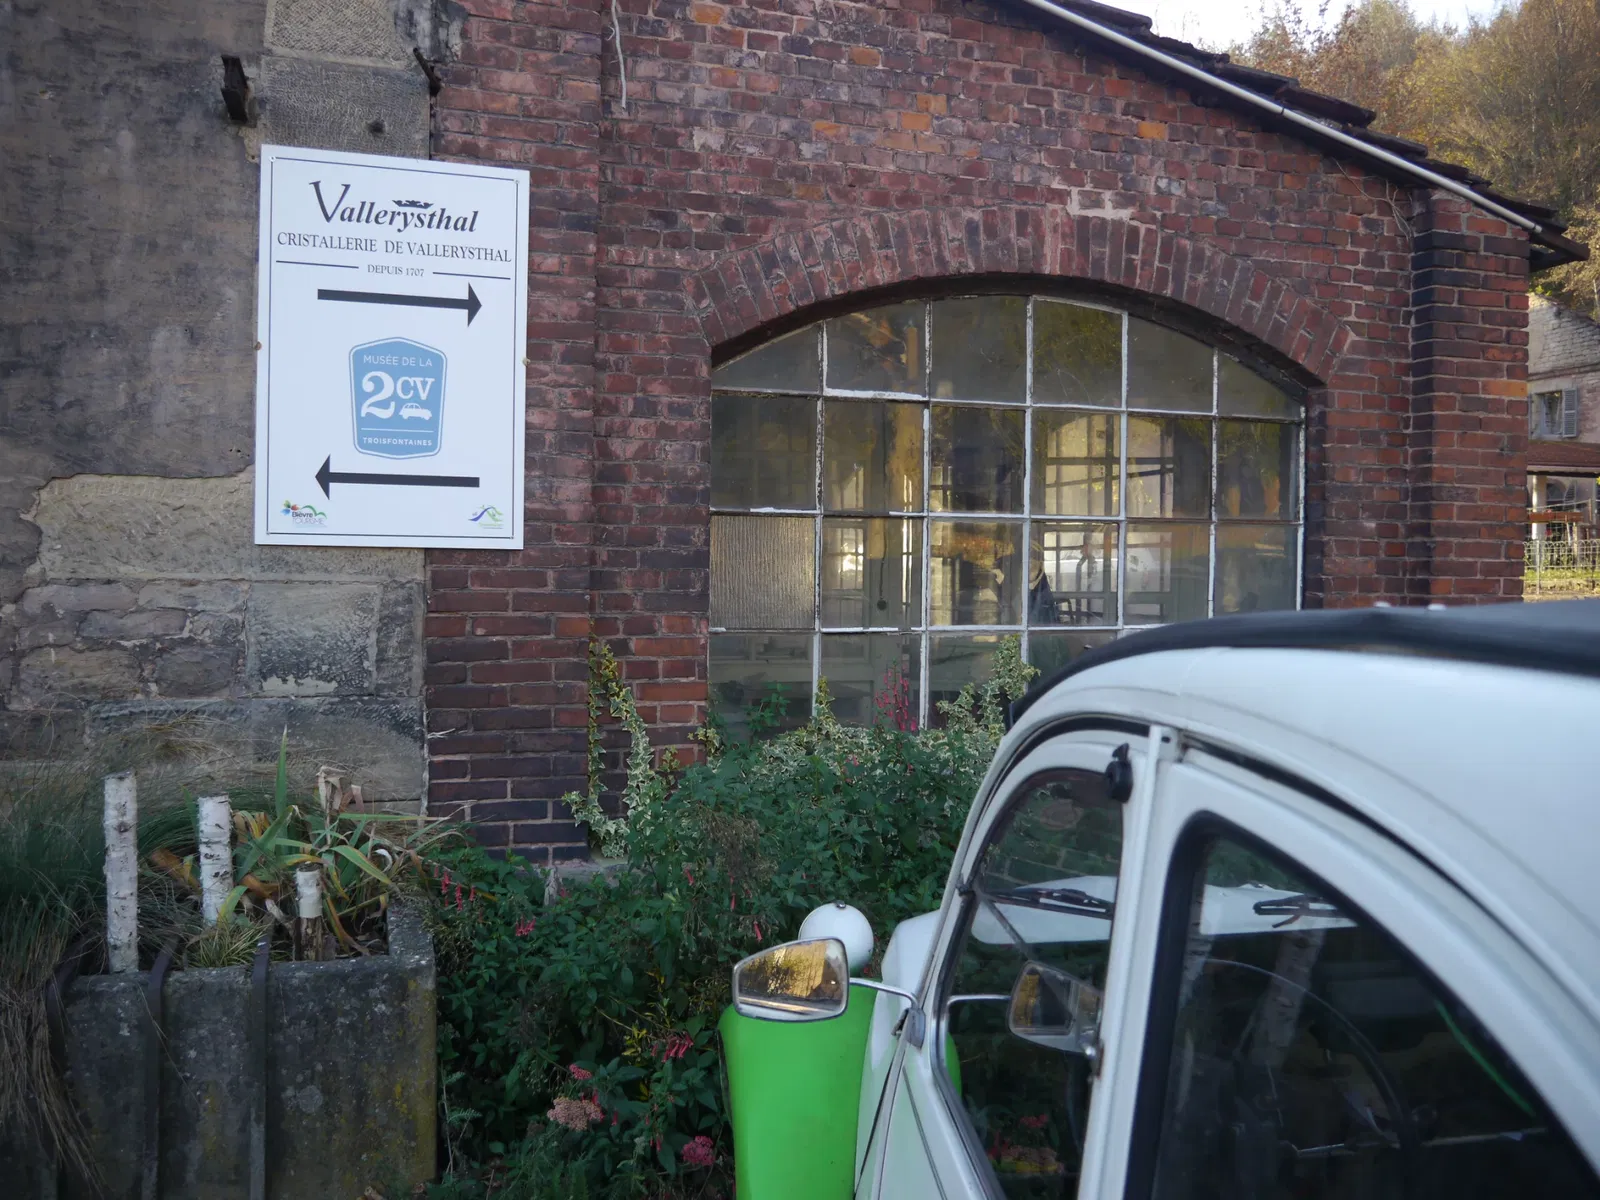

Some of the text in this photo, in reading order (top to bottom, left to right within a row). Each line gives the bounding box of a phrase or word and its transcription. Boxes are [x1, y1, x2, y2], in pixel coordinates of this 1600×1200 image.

[309, 181, 478, 233] Vallerysthal
[277, 232, 512, 262] CRISTALLERIE DE VALLERYSTHAL
[367, 264, 425, 277] DEPUIS 1707
[363, 354, 433, 367] MUSÉE DE LA
[362, 437, 433, 446] TROISFONTAINES
